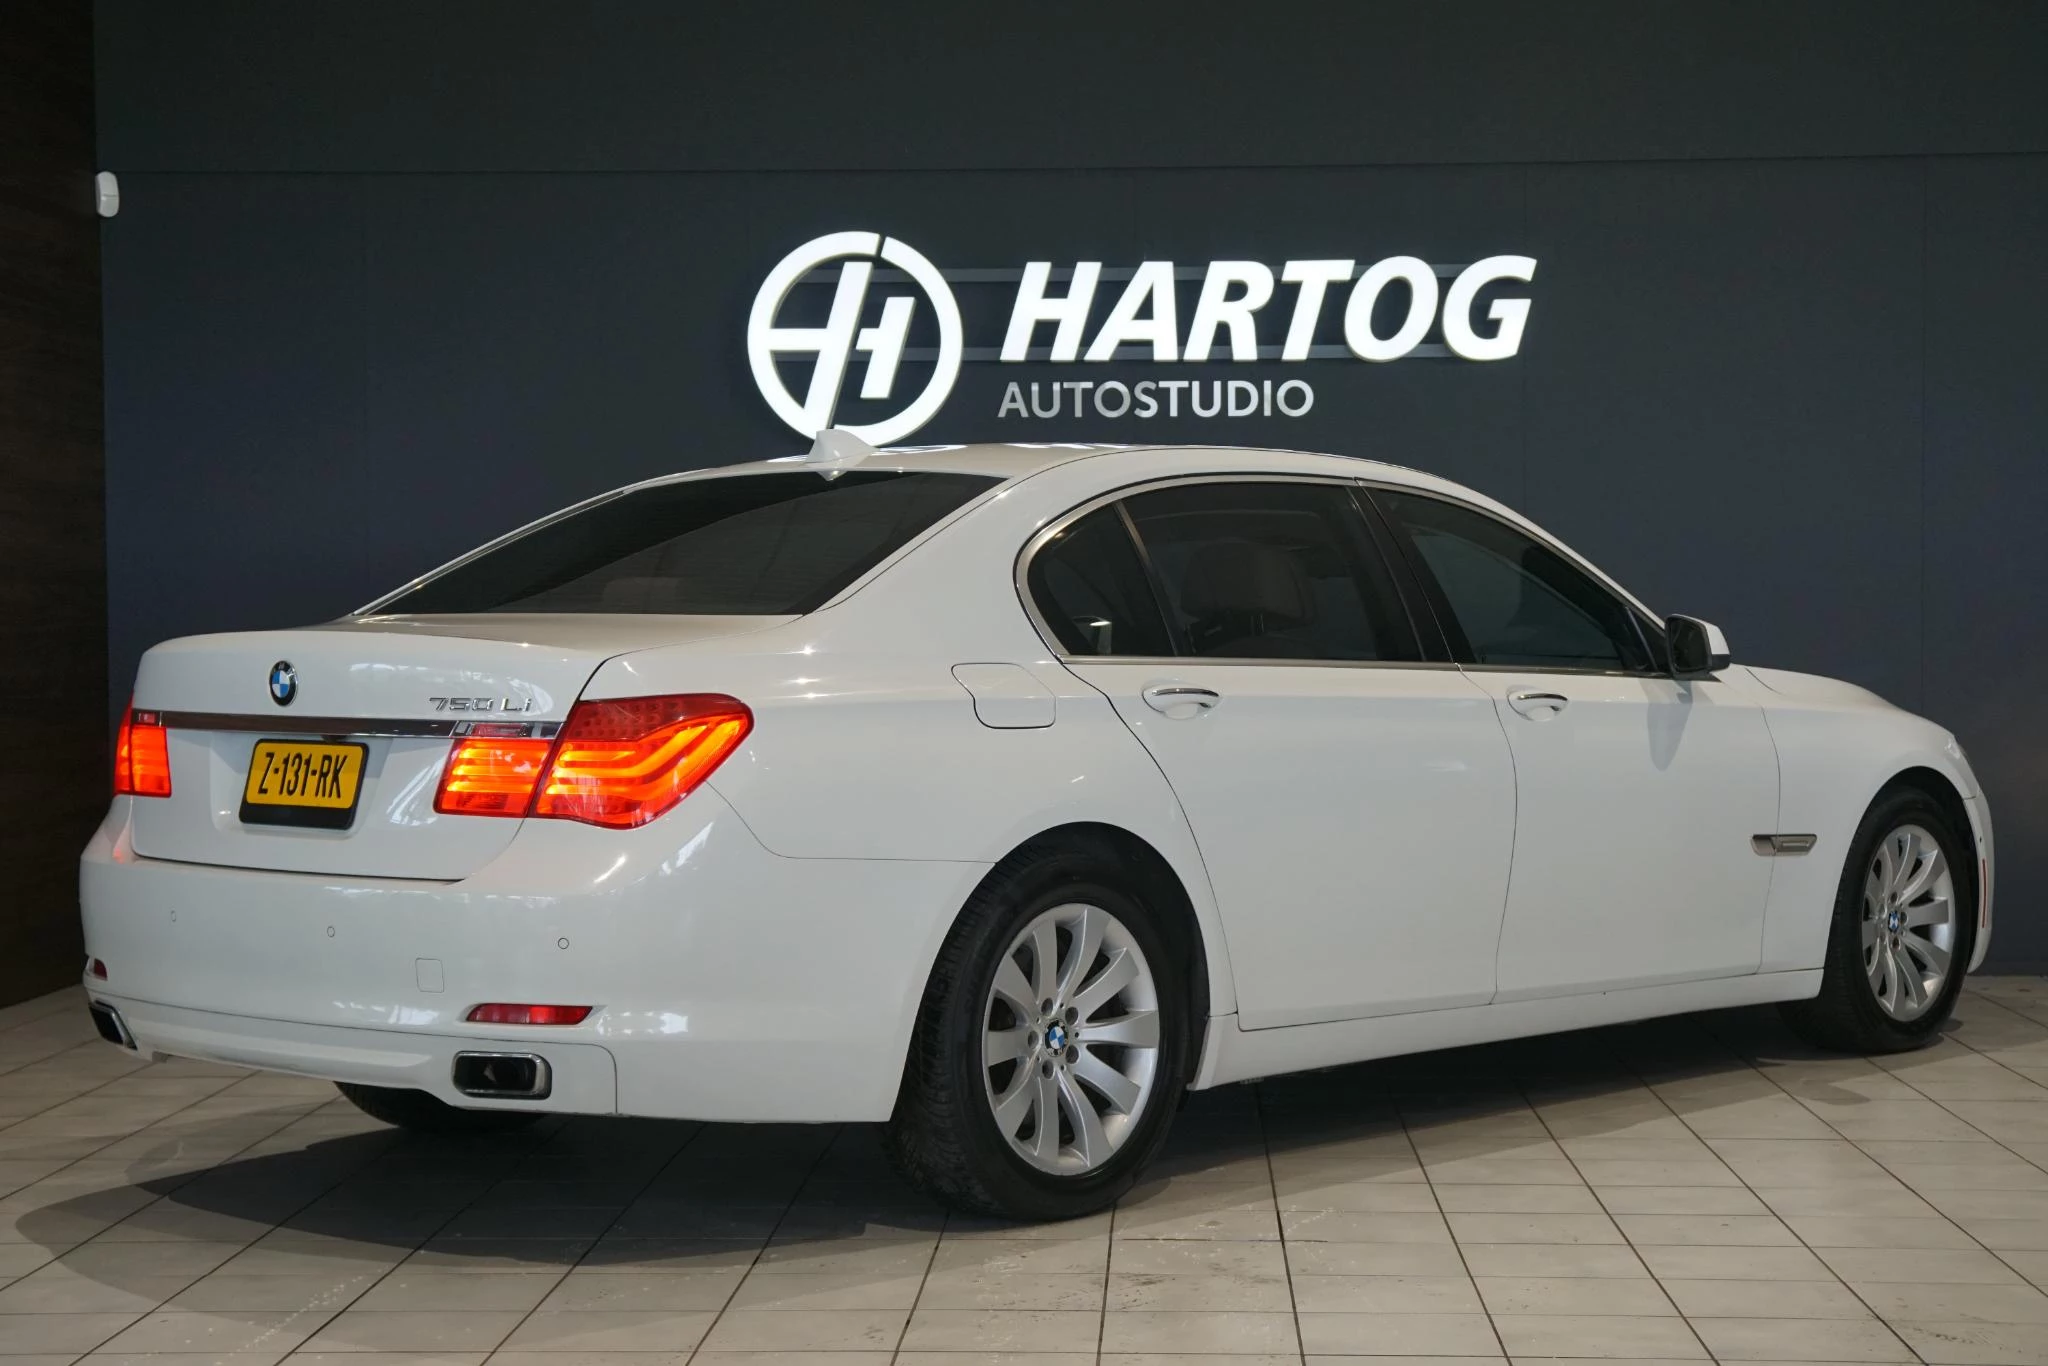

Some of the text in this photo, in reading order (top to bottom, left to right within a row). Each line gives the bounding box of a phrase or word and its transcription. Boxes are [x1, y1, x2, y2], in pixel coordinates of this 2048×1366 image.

[999, 255, 1538, 362] HARTOG
[997, 379, 1315, 418] AUTOSTUDIO
[257, 751, 348, 799] Z-131-RK
